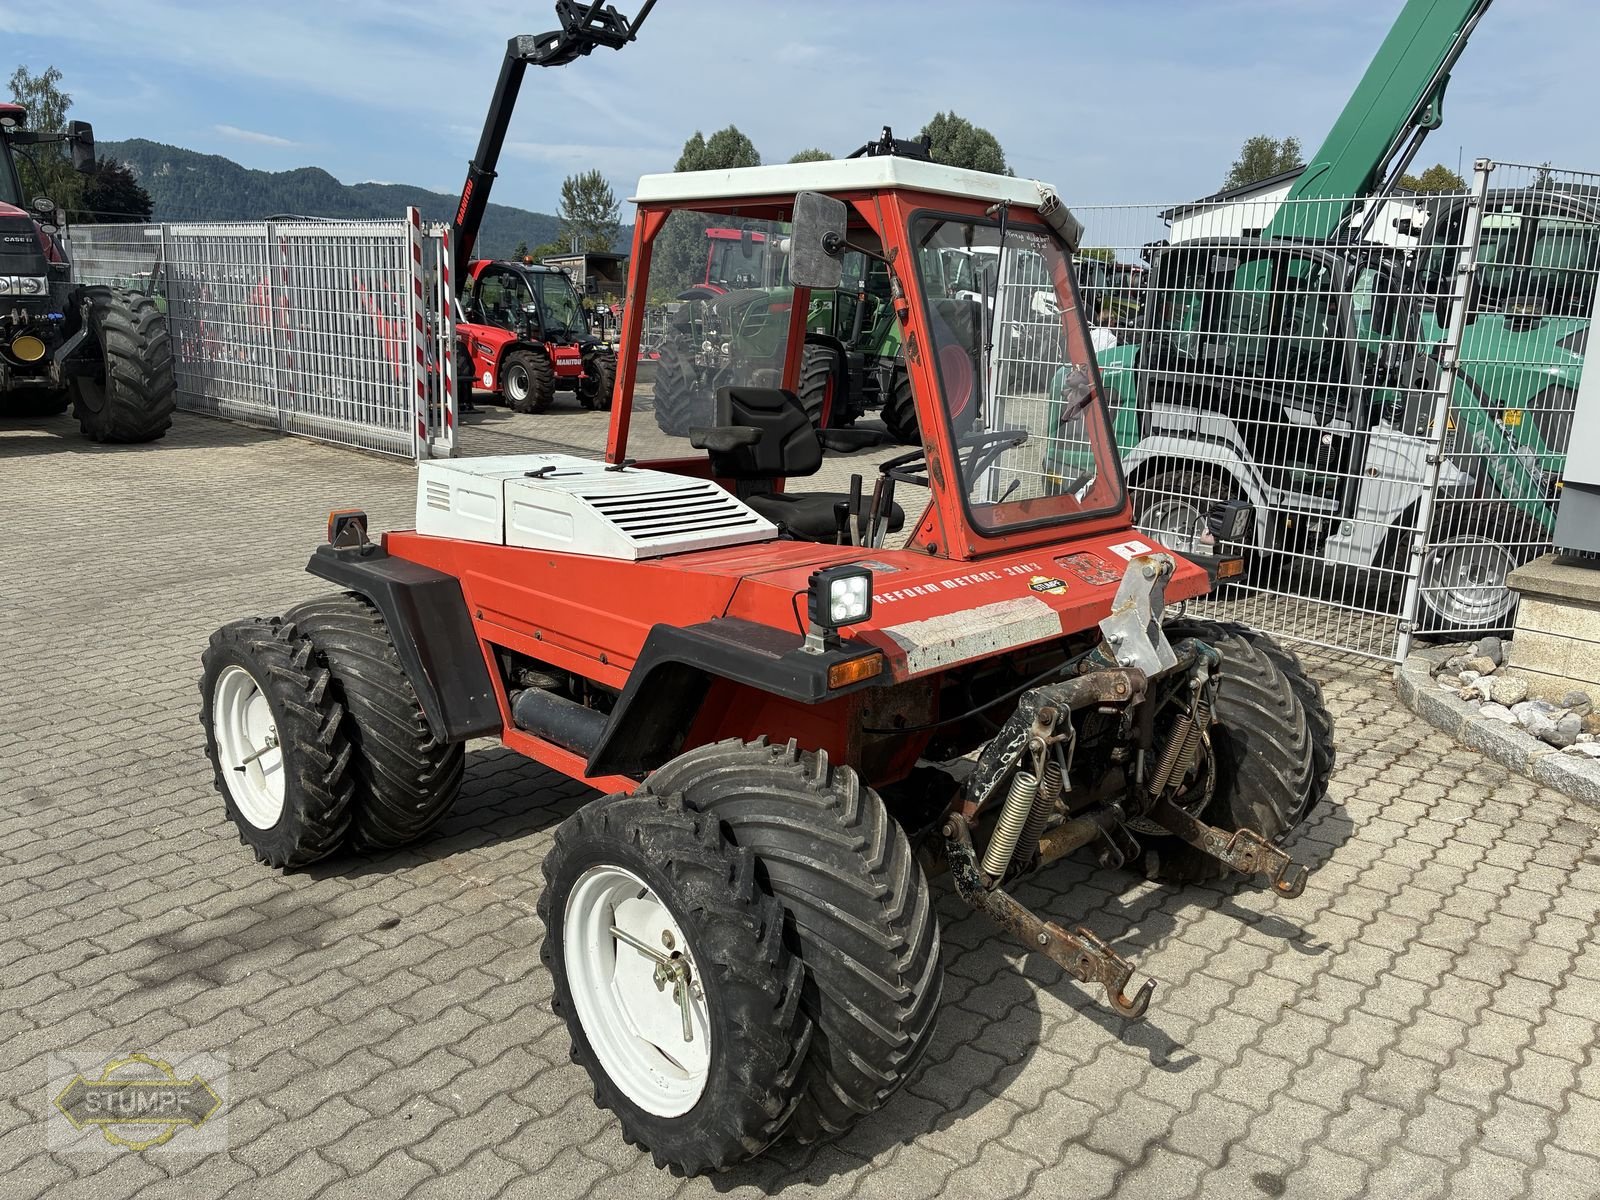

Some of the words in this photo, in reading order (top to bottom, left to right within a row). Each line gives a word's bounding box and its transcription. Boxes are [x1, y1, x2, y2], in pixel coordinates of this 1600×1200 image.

[456, 179, 473, 226] MANITOU
[872, 582, 941, 605] REFORM
[940, 571, 1002, 589] METRAC
[1033, 580, 1061, 590] STUMPF
